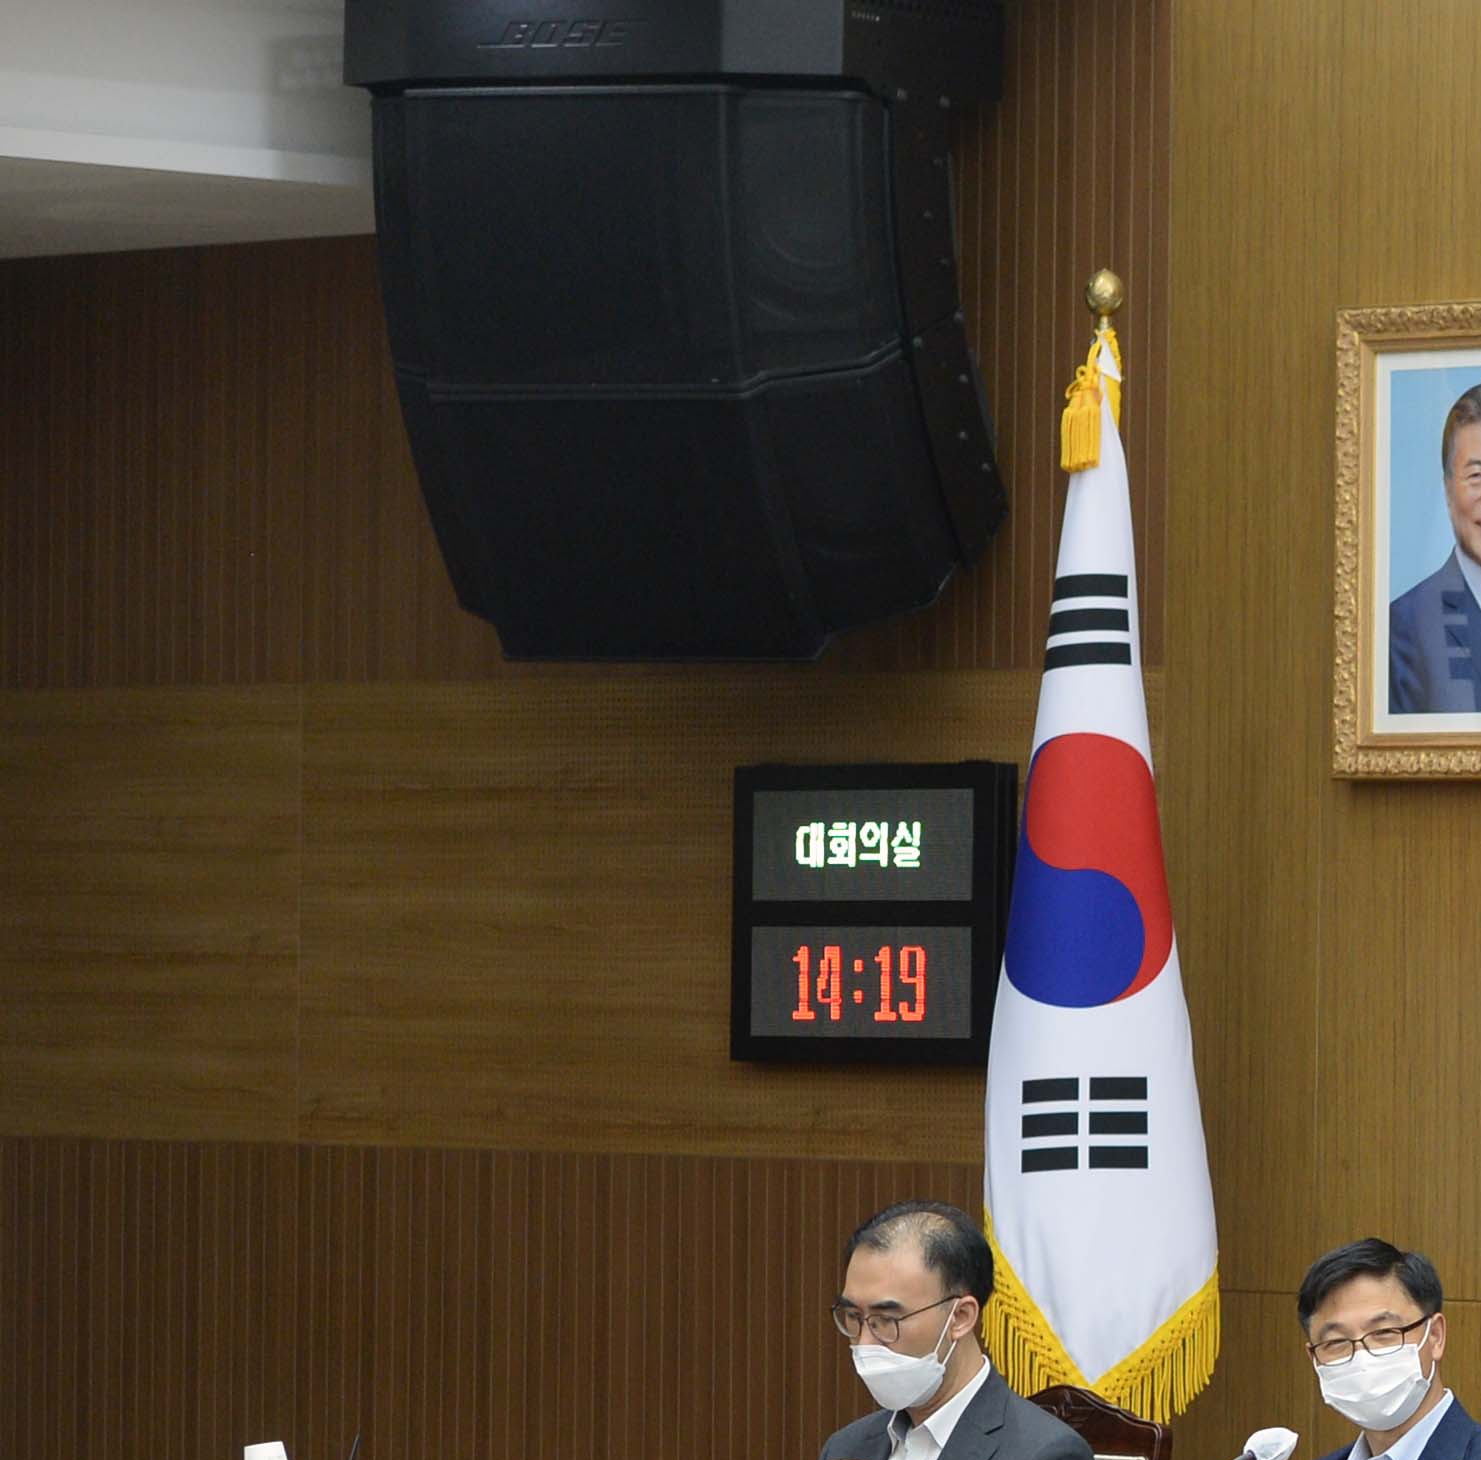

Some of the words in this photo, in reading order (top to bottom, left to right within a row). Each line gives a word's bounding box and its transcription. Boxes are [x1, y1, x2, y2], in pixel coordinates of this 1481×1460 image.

[477, 19, 648, 48] BOSE
[795, 820, 922, 869] 대회의실
[791, 945, 928, 1022] 14:19
